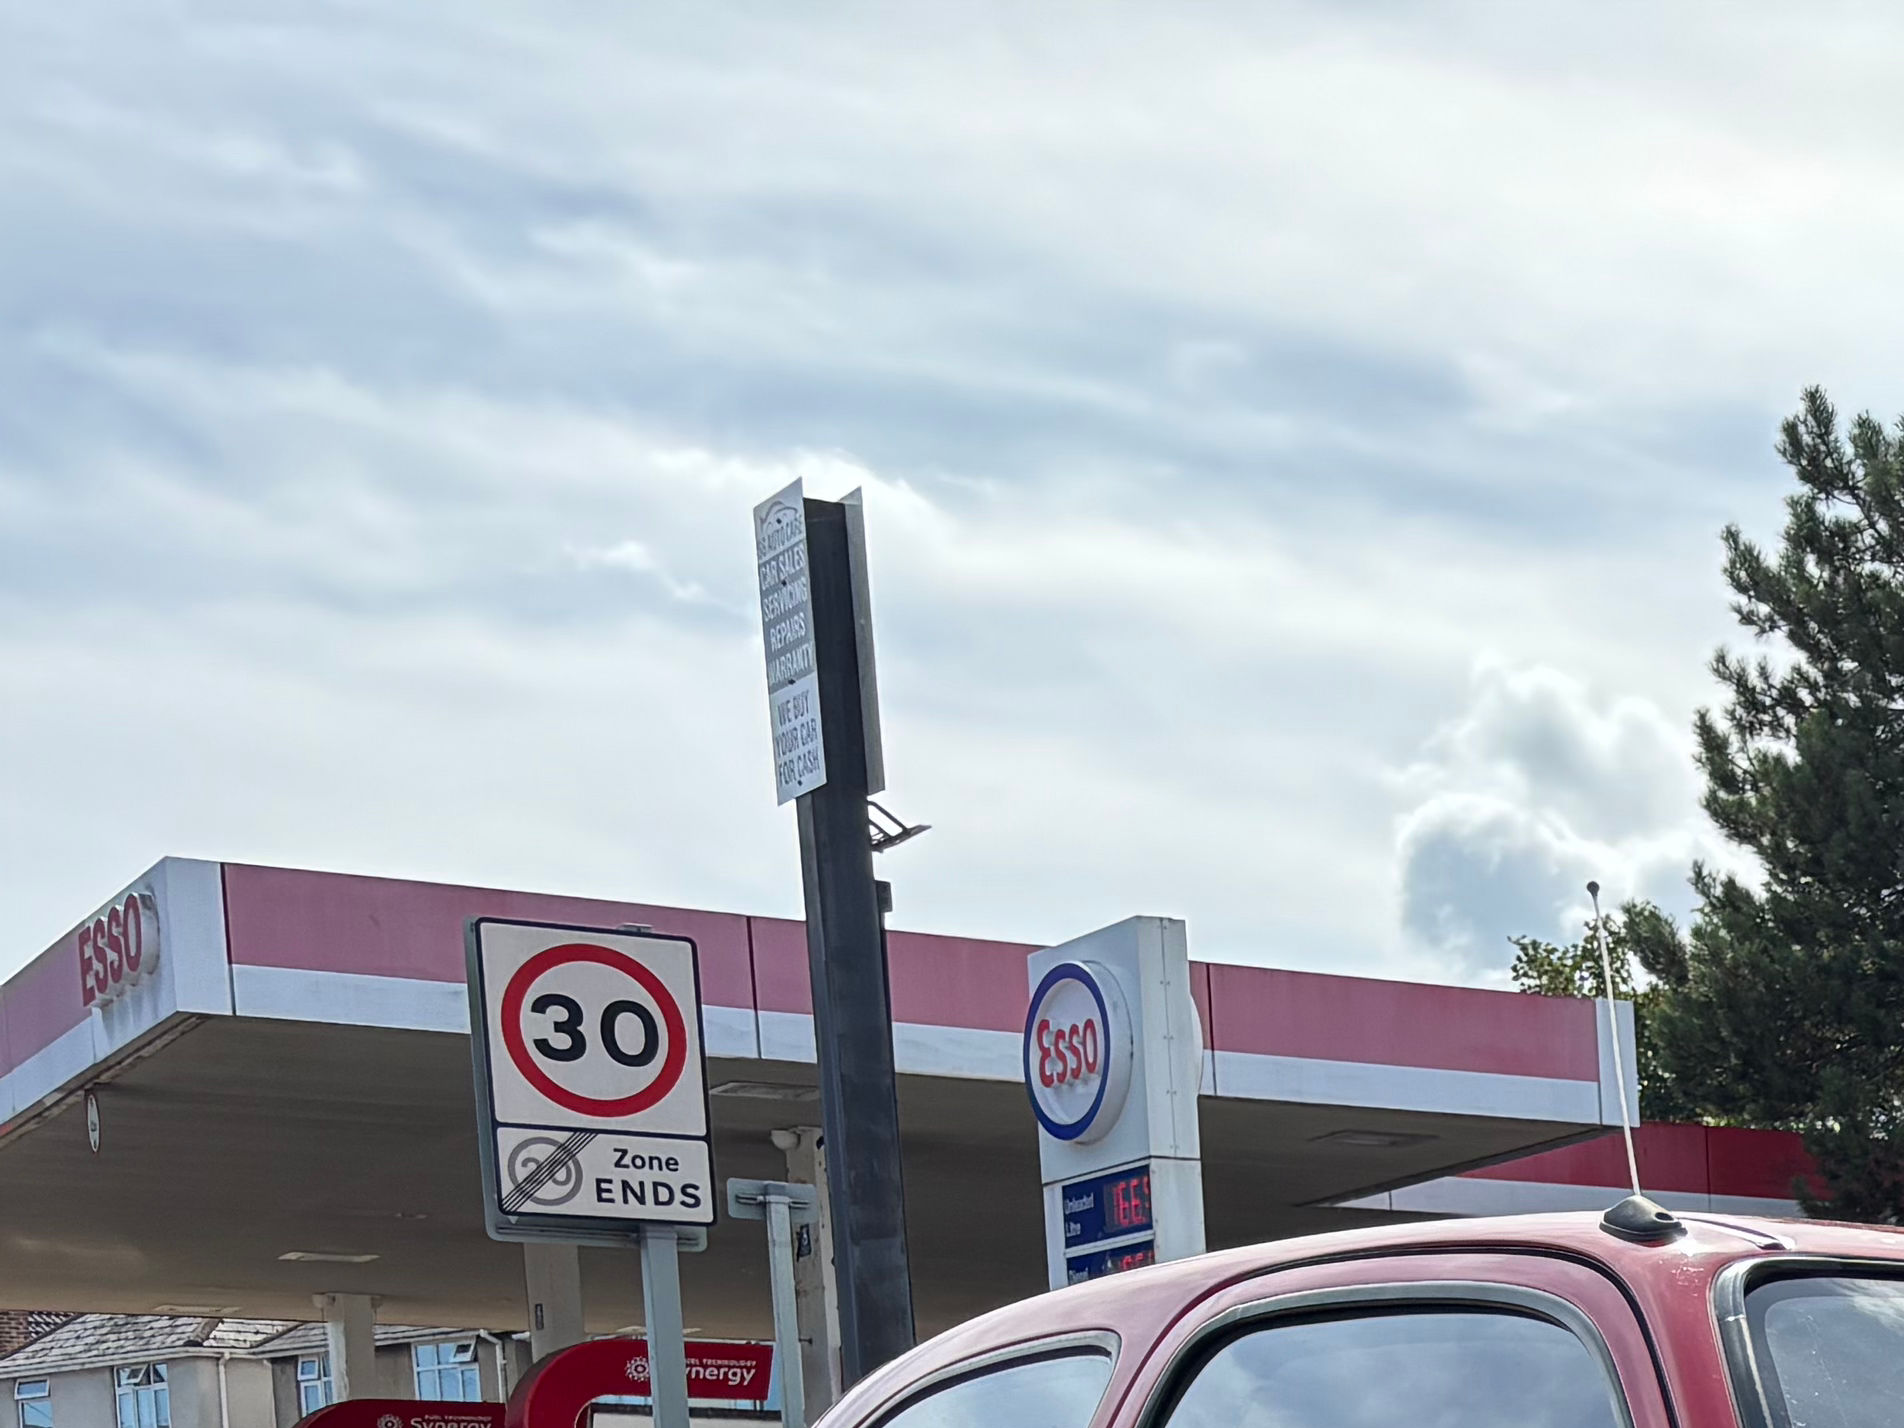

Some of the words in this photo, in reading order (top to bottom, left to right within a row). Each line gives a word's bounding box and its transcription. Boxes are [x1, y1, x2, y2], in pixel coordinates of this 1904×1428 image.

[761, 559, 778, 591] CAR
[778, 543, 806, 579] SALES
[763, 576, 808, 623] SERVICING
[770, 612, 806, 652] REPAIRS
[767, 641, 813, 684] WARRANTY
[778, 699, 791, 727] WE
[793, 689, 809, 719] BUY
[775, 727, 800, 760] YOUR
[800, 717, 818, 746] CAR
[779, 758, 797, 787] FOR
[797, 746, 820, 778] CASH
[530, 993, 660, 1068] 30
[613, 1148, 679, 1172] Zone
[595, 1177, 702, 1209] ENDS
[686, 1366, 755, 1386] nergy
